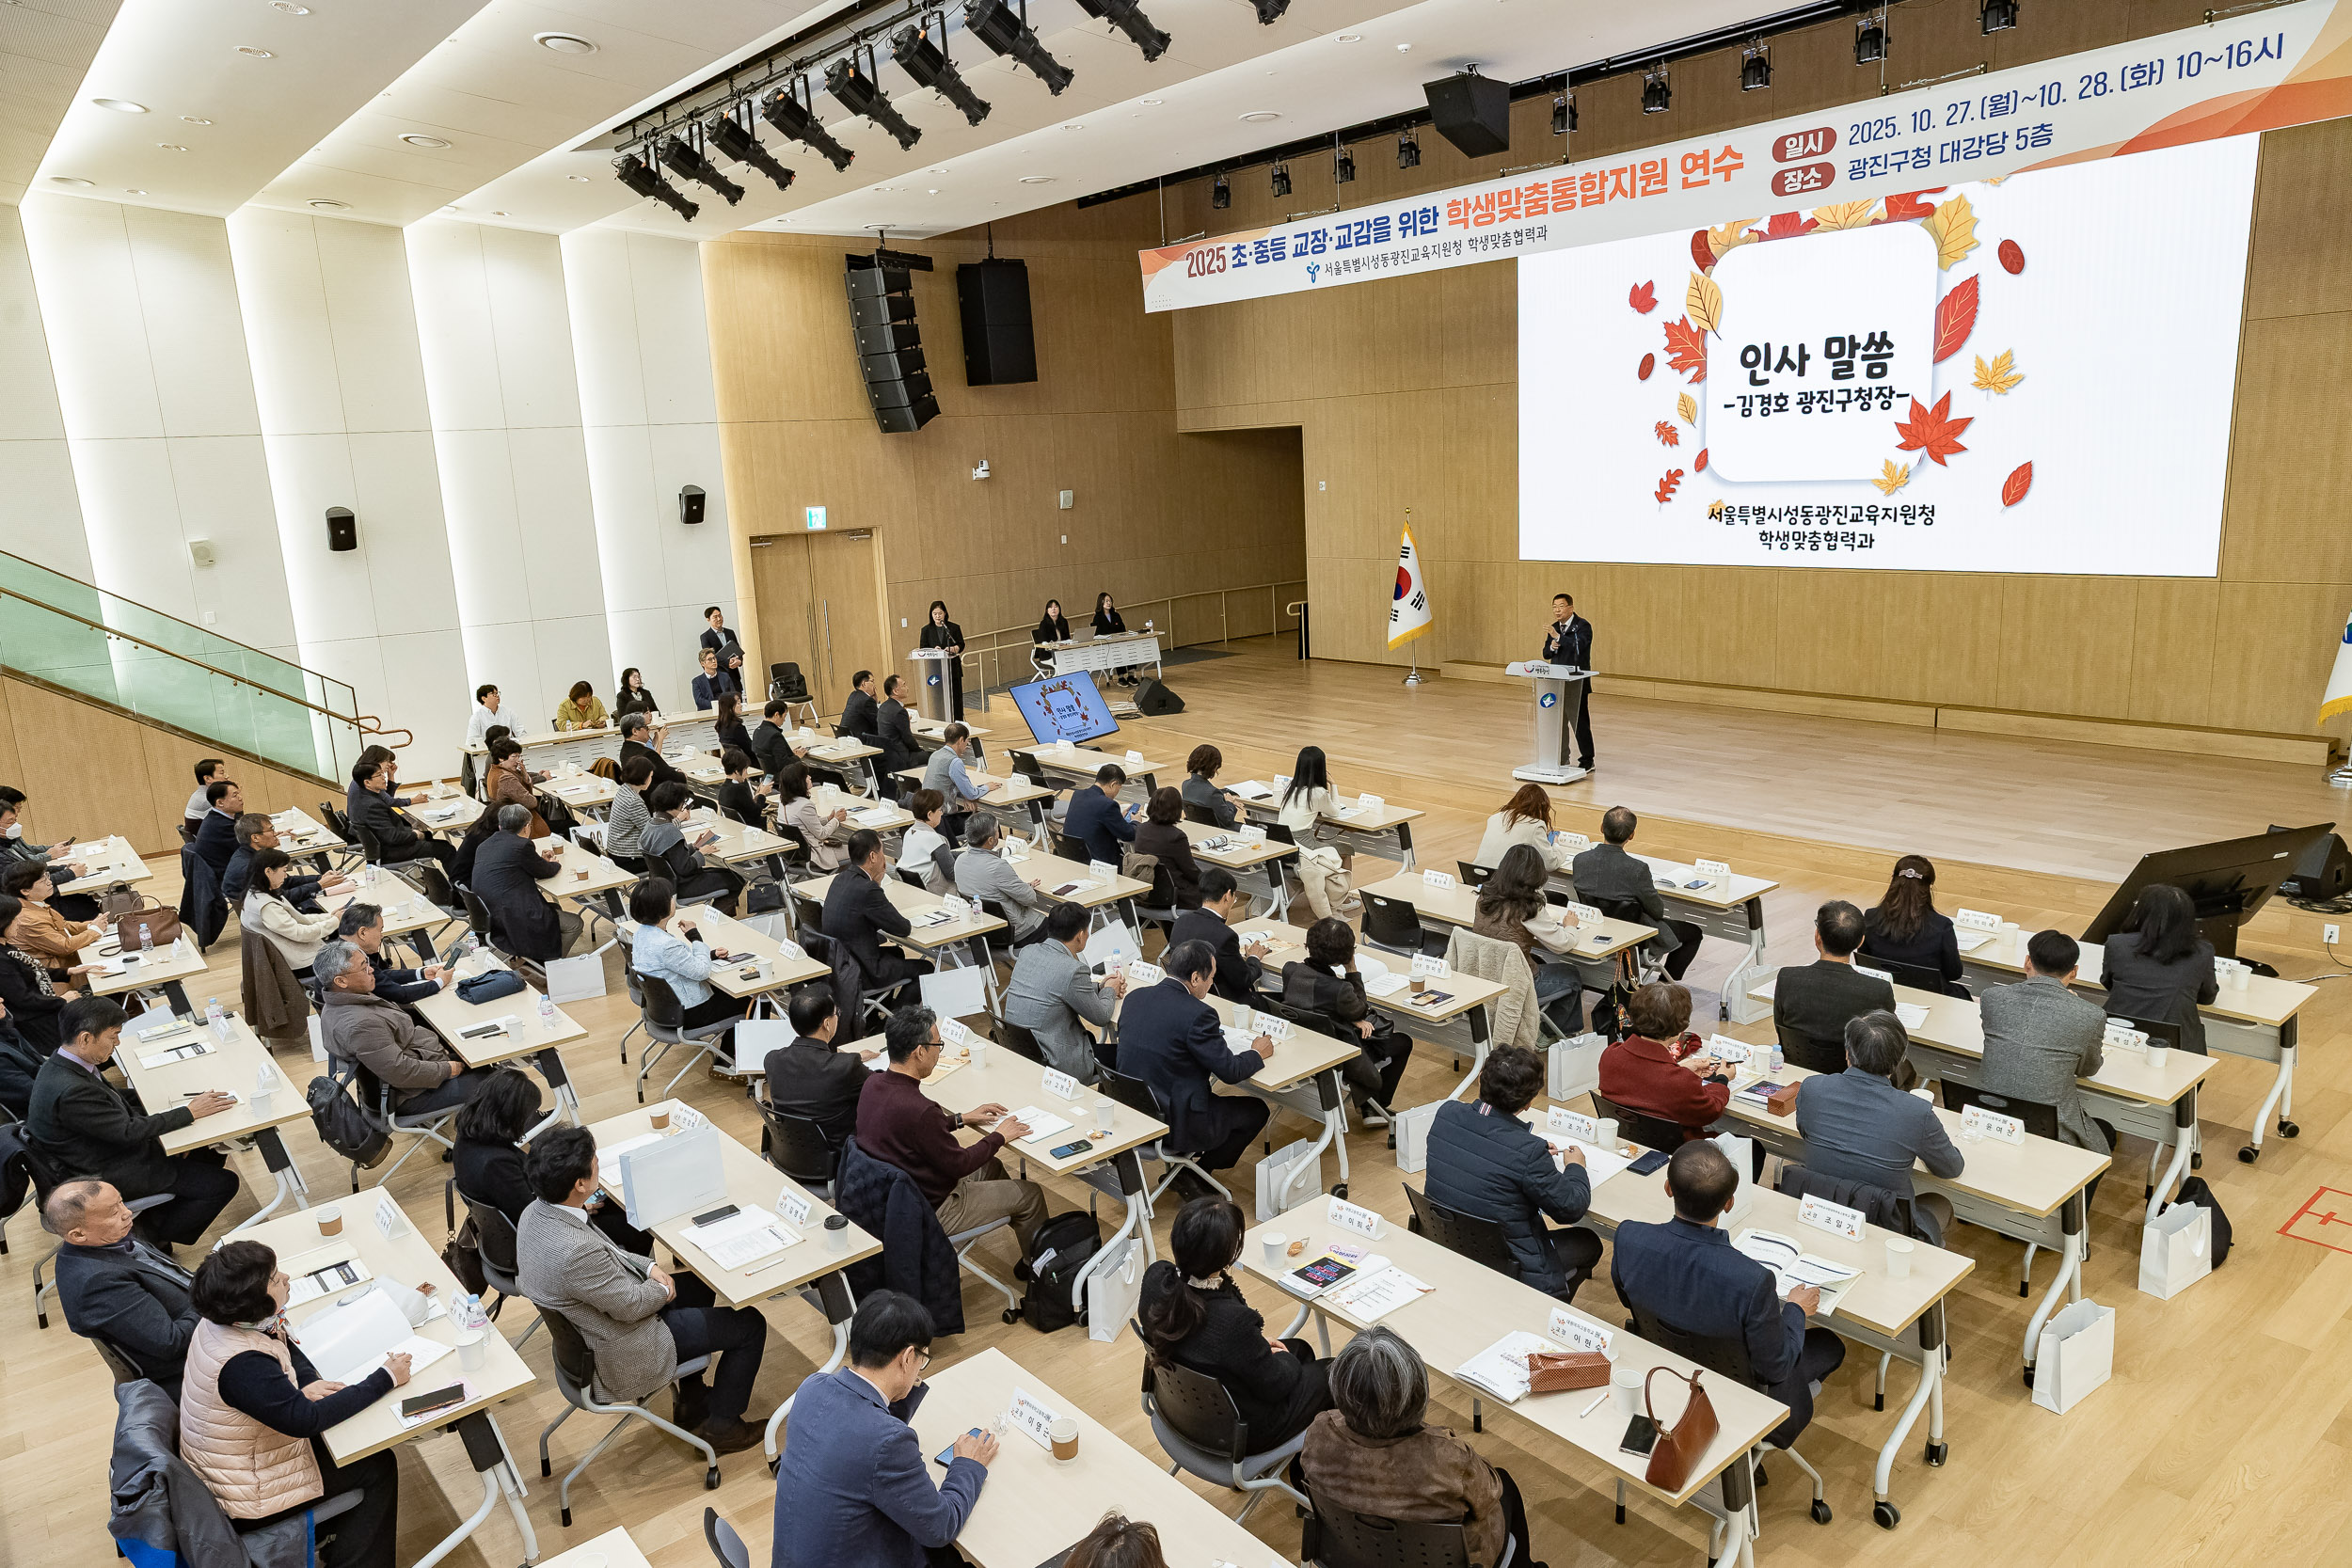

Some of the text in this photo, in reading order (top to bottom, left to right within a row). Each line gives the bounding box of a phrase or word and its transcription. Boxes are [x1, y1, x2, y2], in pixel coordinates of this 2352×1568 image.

[1784, 130, 1824, 160] 일시
[1849, 116, 1901, 146] 2025.
[1911, 108, 1936, 134] 10.
[2176, 32, 2284, 80] 10~16시
[1783, 122, 2055, 193] 장소 광진구청 대강당 5층
[1185, 144, 1744, 278] 2025 초·중등 교장·교감을 위한 학생맞춤통합지원 연수
[1324, 224, 1549, 277] 서울특별시성동광진교육지원청 학생맞춤협력과
[1740, 330, 1895, 387] 인사 말씀
[1708, 503, 1936, 527] 서울특별시성동광진교육지원청
[1758, 530, 1875, 552] 학생맞춤협력과
